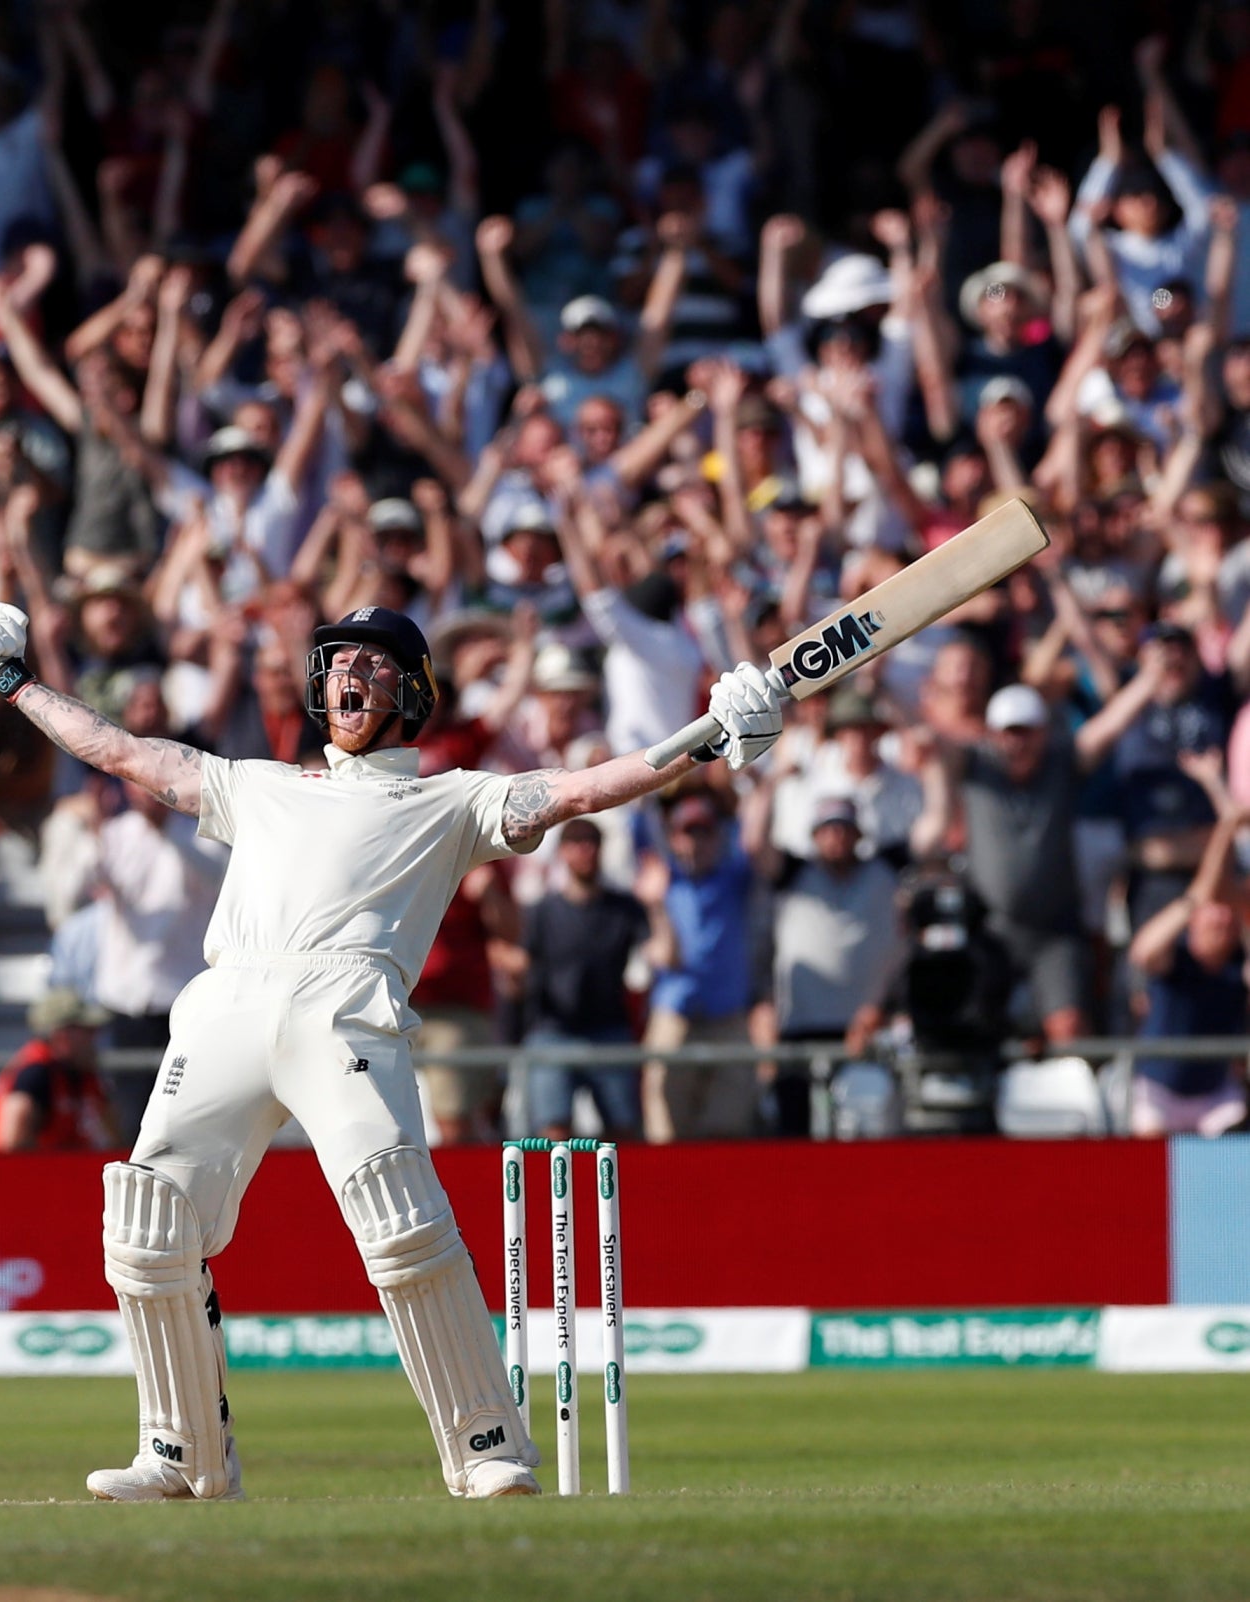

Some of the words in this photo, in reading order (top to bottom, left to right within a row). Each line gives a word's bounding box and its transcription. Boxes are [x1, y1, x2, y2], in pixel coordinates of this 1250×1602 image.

[792, 613, 872, 680] GM
[508, 1163, 517, 1199] Specsavers
[554, 1159, 563, 1196] Specsavers
[602, 1160, 611, 1197] Specsavers
[555, 1210, 568, 1242] The
[556, 1245, 569, 1281] Test
[602, 1234, 617, 1327] Specsavers
[508, 1237, 521, 1330] Specsavers
[556, 1285, 569, 1349] Experts
[152, 1437, 183, 1462] GM
[469, 1425, 506, 1452] GM
